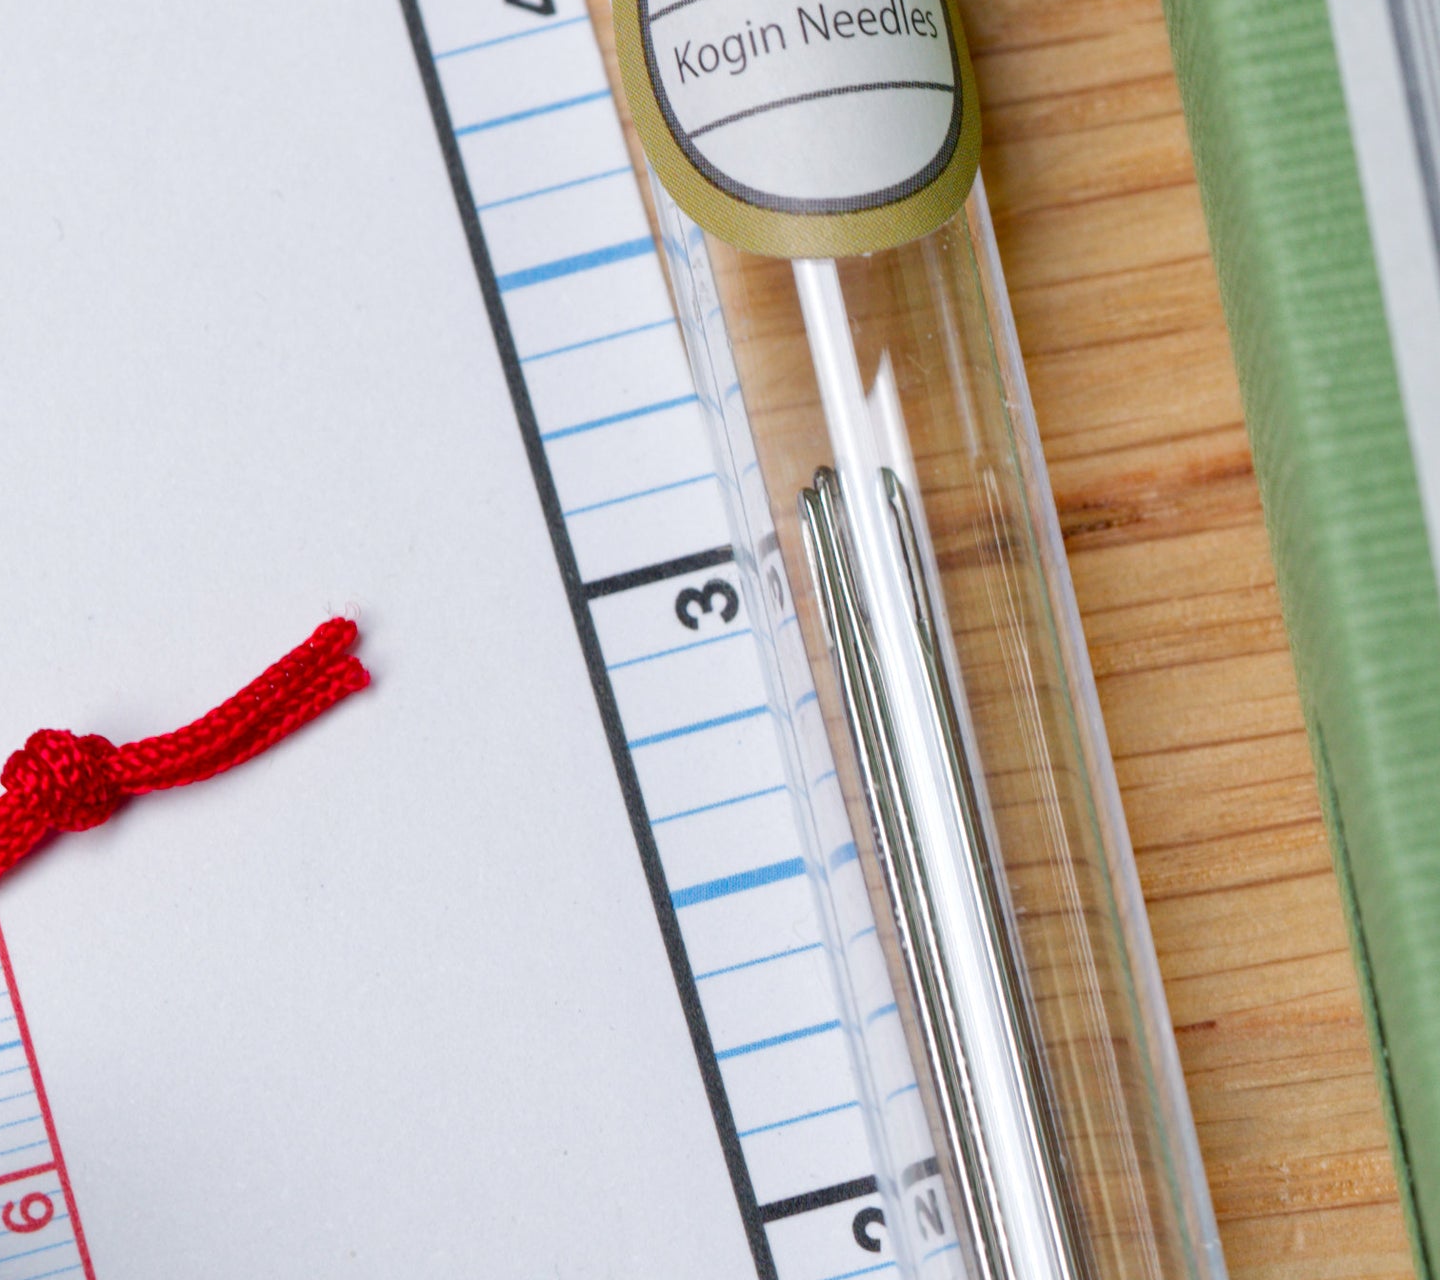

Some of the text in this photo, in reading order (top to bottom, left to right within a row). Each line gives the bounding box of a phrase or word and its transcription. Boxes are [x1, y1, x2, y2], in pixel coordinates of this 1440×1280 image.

[673, 18, 787, 84] Kogin
[674, 576, 742, 632] 3
[2, 1187, 55, 1237] 6
